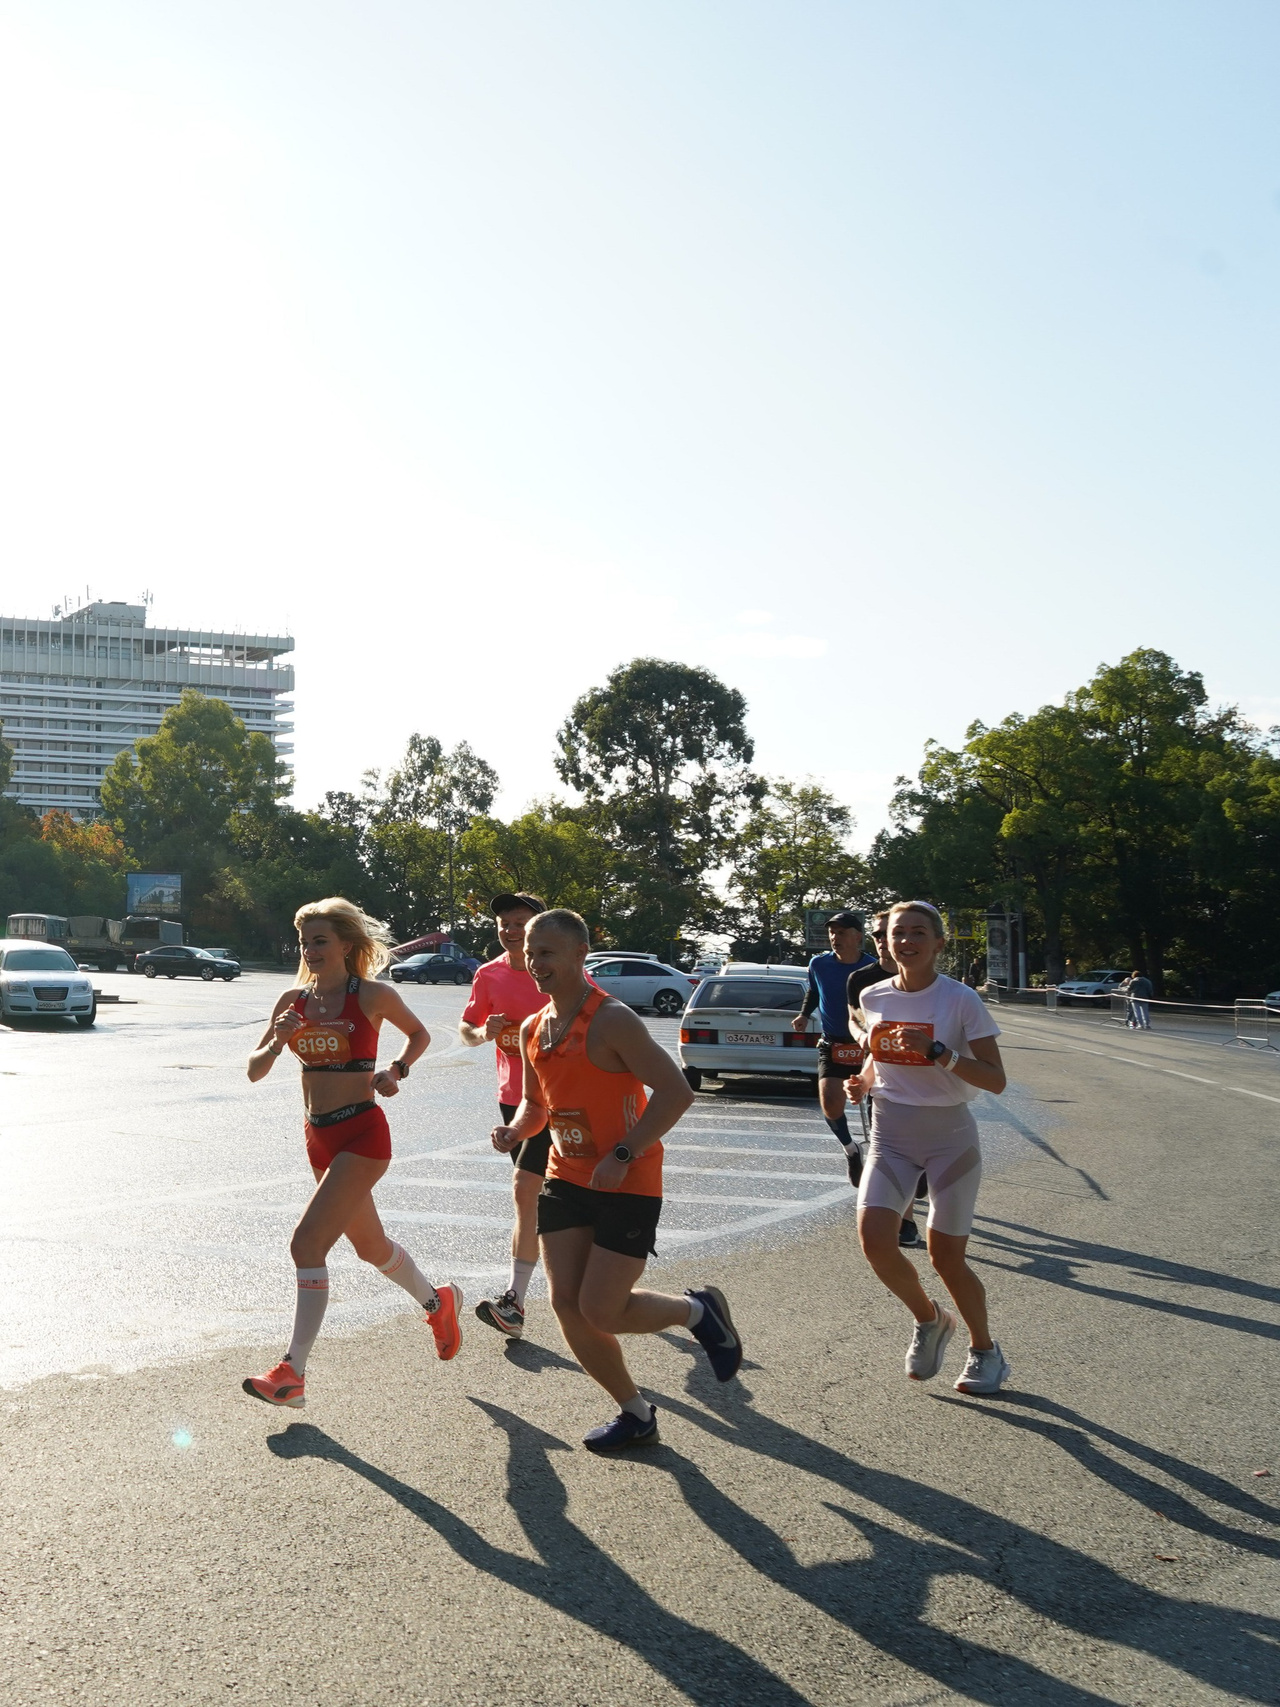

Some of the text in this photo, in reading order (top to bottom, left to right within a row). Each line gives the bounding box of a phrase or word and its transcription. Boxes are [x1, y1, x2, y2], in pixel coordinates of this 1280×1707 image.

[297, 1036, 339, 1054] 8199
[837, 1049, 863, 1059] 8797
[330, 1105, 357, 1121] RAY
